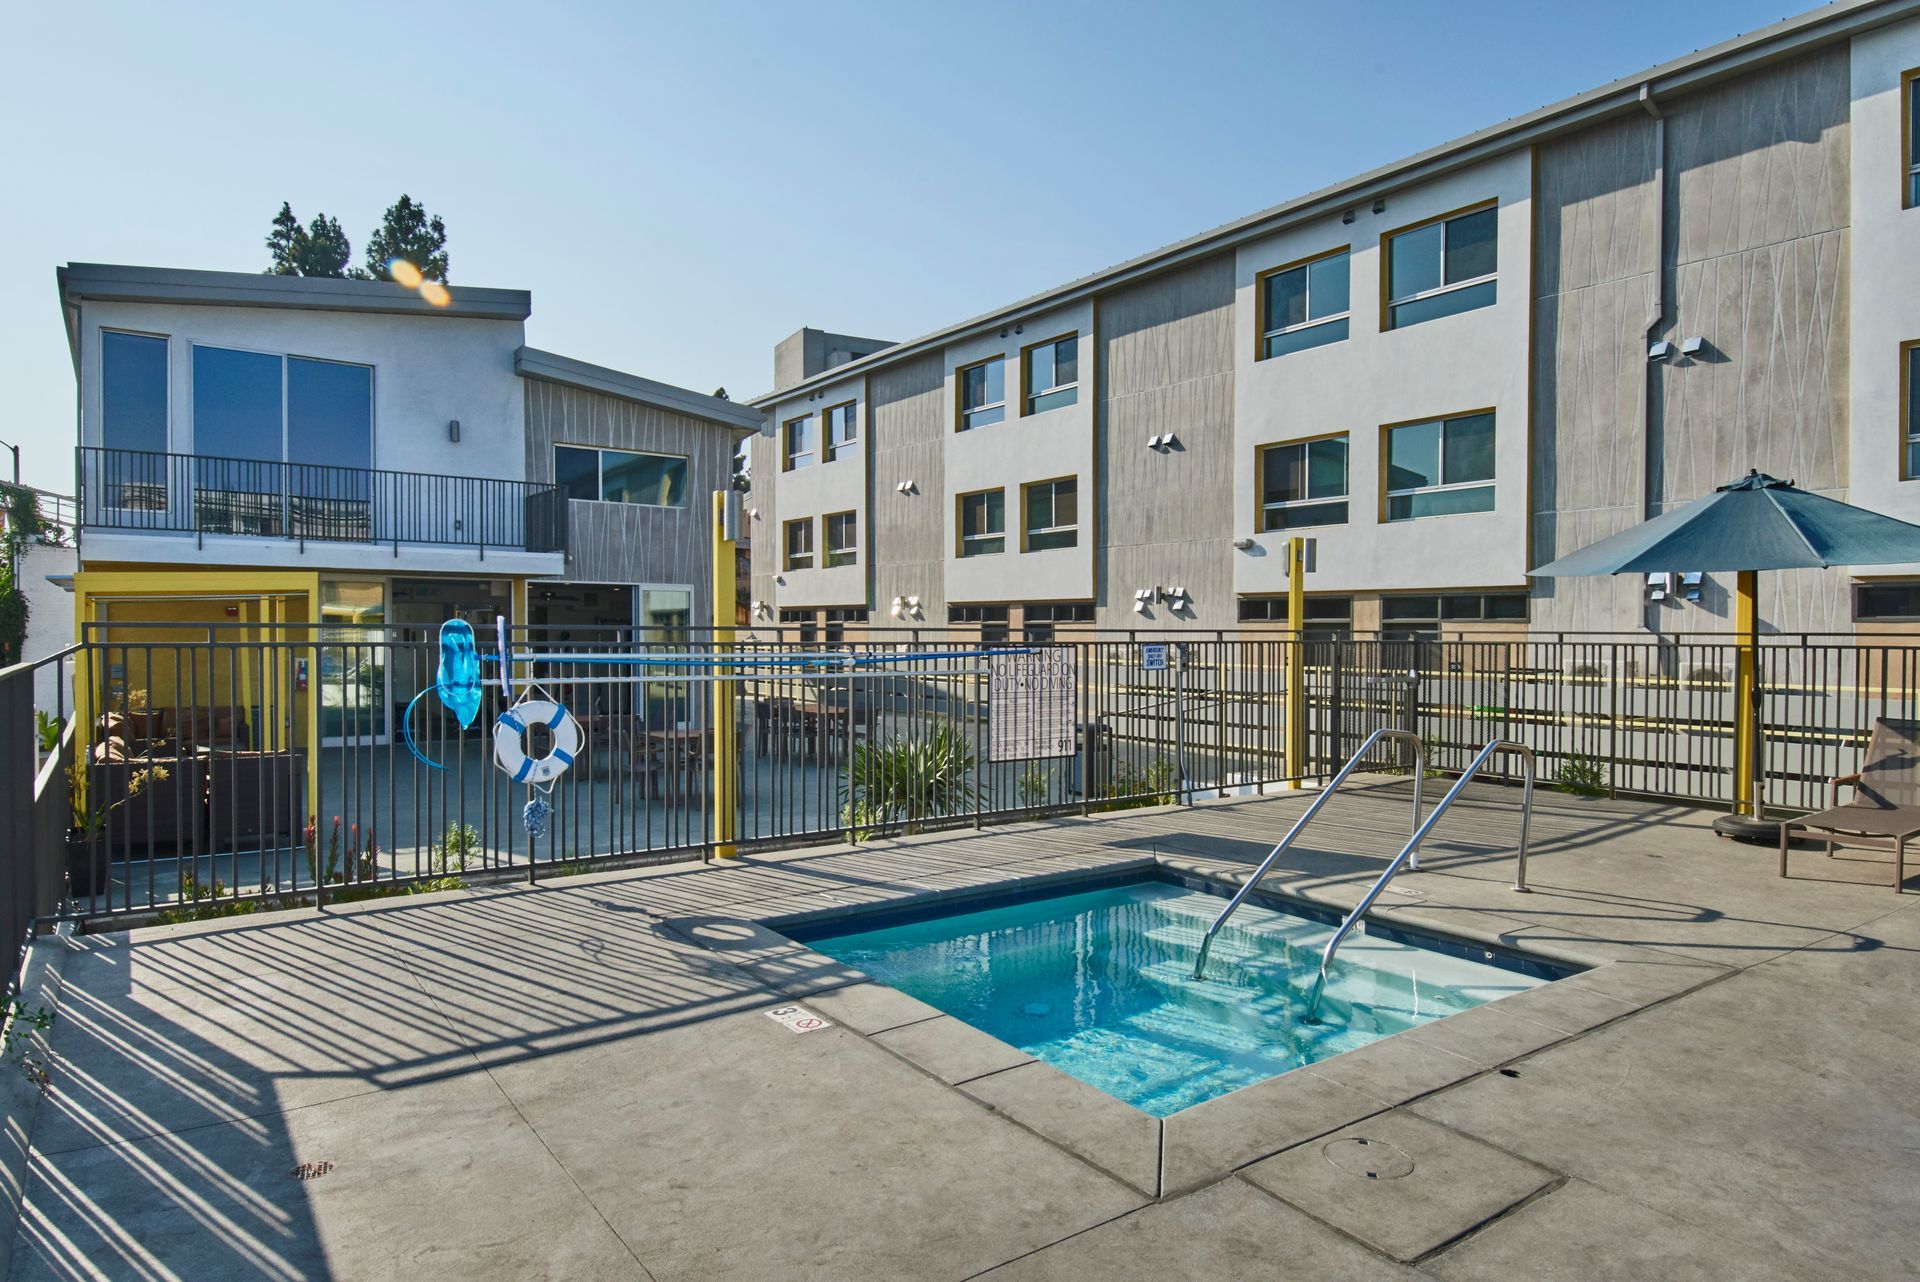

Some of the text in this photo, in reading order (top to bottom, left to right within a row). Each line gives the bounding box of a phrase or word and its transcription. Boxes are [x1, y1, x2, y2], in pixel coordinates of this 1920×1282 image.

[1007, 649, 1061, 663] WARNING
[1146, 659, 1164, 667] SWITCH
[1058, 739, 1072, 752] 911
